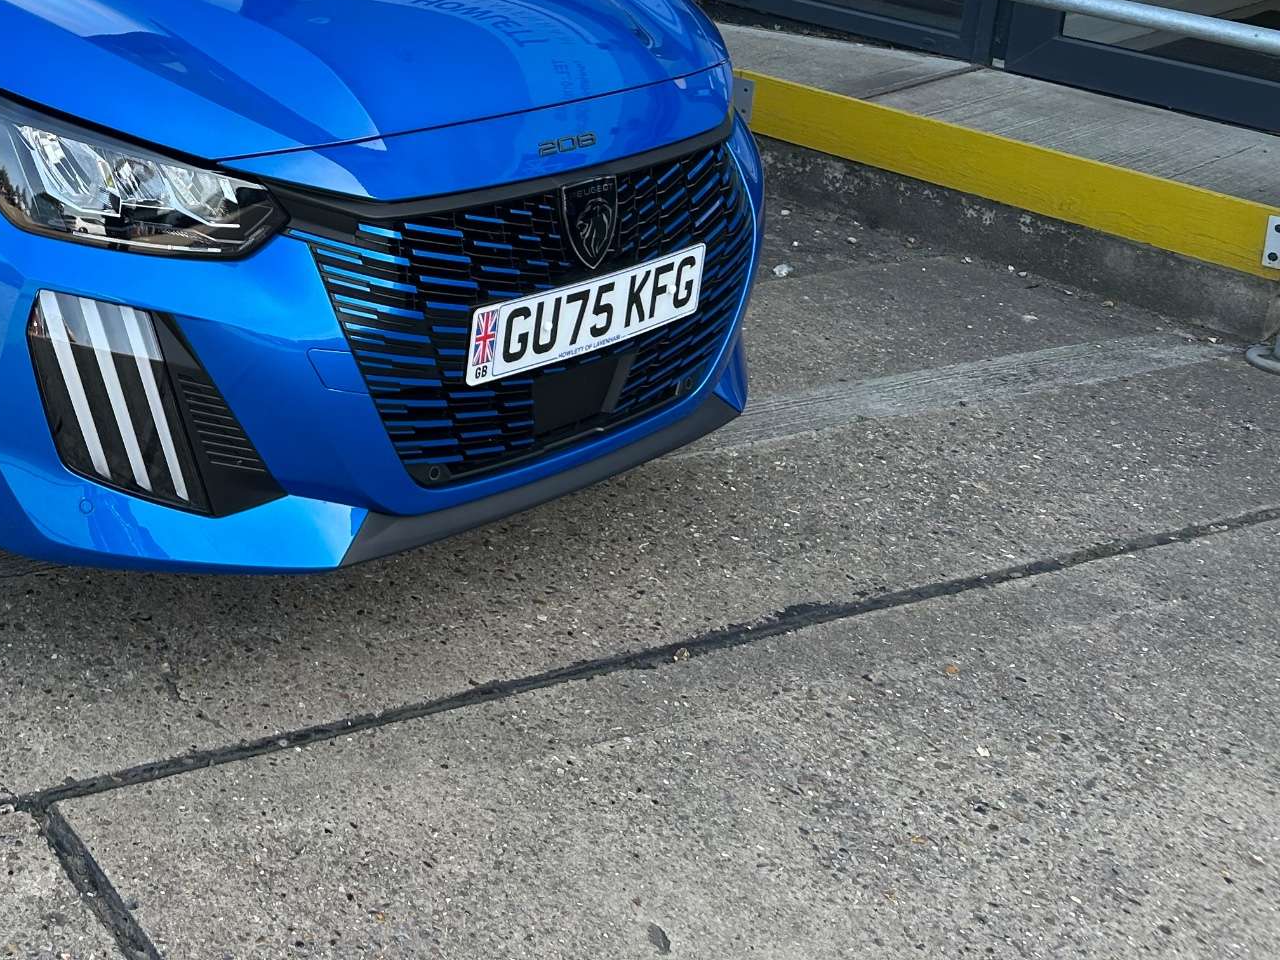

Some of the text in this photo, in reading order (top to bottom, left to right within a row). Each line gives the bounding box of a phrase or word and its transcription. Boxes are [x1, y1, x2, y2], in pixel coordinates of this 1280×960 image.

[538, 133, 597, 158] 208
[502, 255, 696, 364] GU75 KFG
[558, 345, 584, 358] HOWLETT
[475, 365, 488, 379] GB
